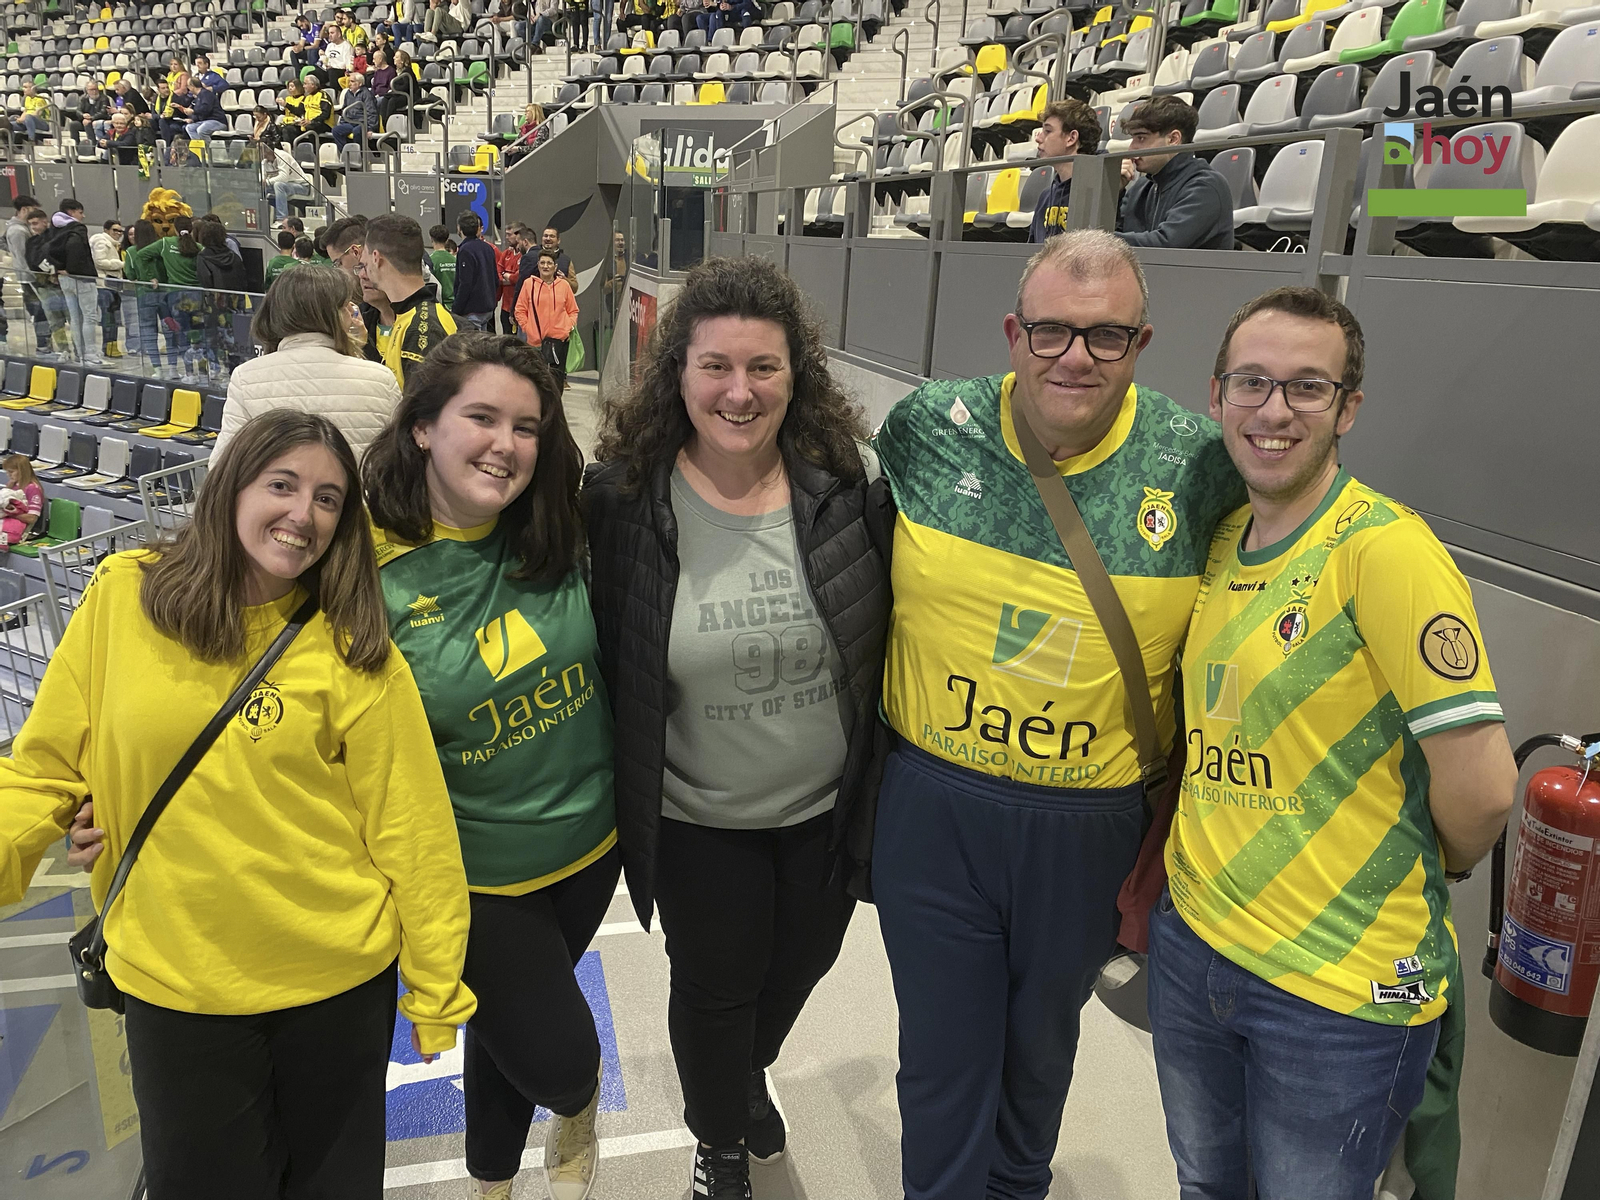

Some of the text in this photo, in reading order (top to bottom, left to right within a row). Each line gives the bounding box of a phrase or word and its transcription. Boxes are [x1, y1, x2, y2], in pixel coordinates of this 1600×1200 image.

[662, 134, 732, 168] alida
[444, 178, 481, 193] Sector
[694, 175, 719, 185] SALI
[458, 177, 489, 235] 3
[932, 428, 958, 437] GREEN
[958, 427, 985, 436] ENERG
[1158, 452, 1187, 466] JADISA
[749, 569, 792, 592] LOS
[698, 592, 813, 633] ANGEL
[732, 624, 827, 695] 98
[468, 662, 586, 746] Jaén
[704, 702, 754, 721] CITY
[762, 695, 786, 717] OF
[944, 674, 1098, 760] Jaén
[461, 724, 536, 766] PARAÍSO
[923, 723, 1008, 766] PARAÍSO
[1188, 728, 1273, 789] Jaén
[1223, 790, 1302, 812] INTERIOR
[1545, 840, 1584, 856] INCENDIOS
[1526, 970, 1541, 981] 642
